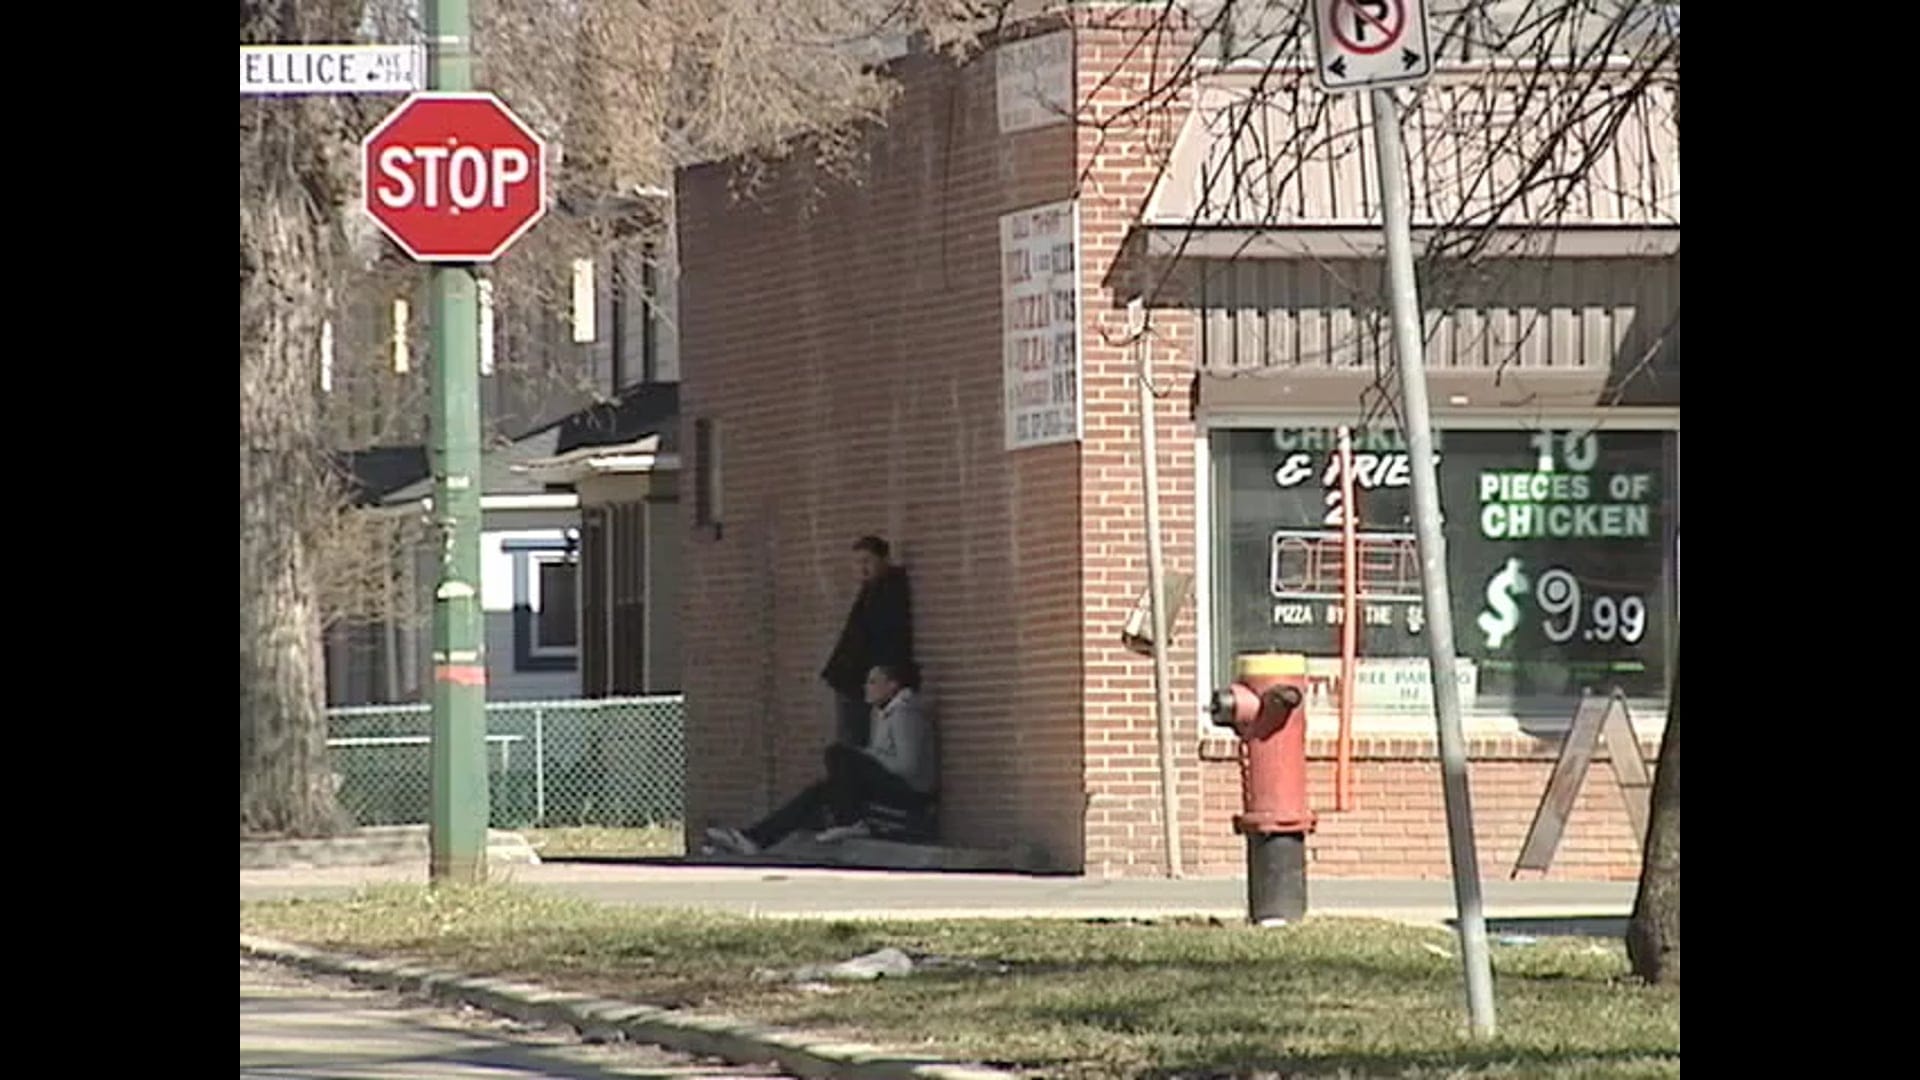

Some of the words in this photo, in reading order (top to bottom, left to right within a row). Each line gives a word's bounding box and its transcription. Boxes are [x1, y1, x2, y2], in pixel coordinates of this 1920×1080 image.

[246, 54, 356, 84] ELLICE
[377, 146, 529, 208] STOP
[1531, 430, 1599, 471] 10
[1275, 454, 1312, 486] &
[1480, 474, 1590, 501] PIECES
[1609, 474, 1650, 500] OF
[1481, 503, 1648, 538] CHICKEN
[1274, 605, 1313, 624] PIZZA
[1365, 605, 1393, 624] THE
